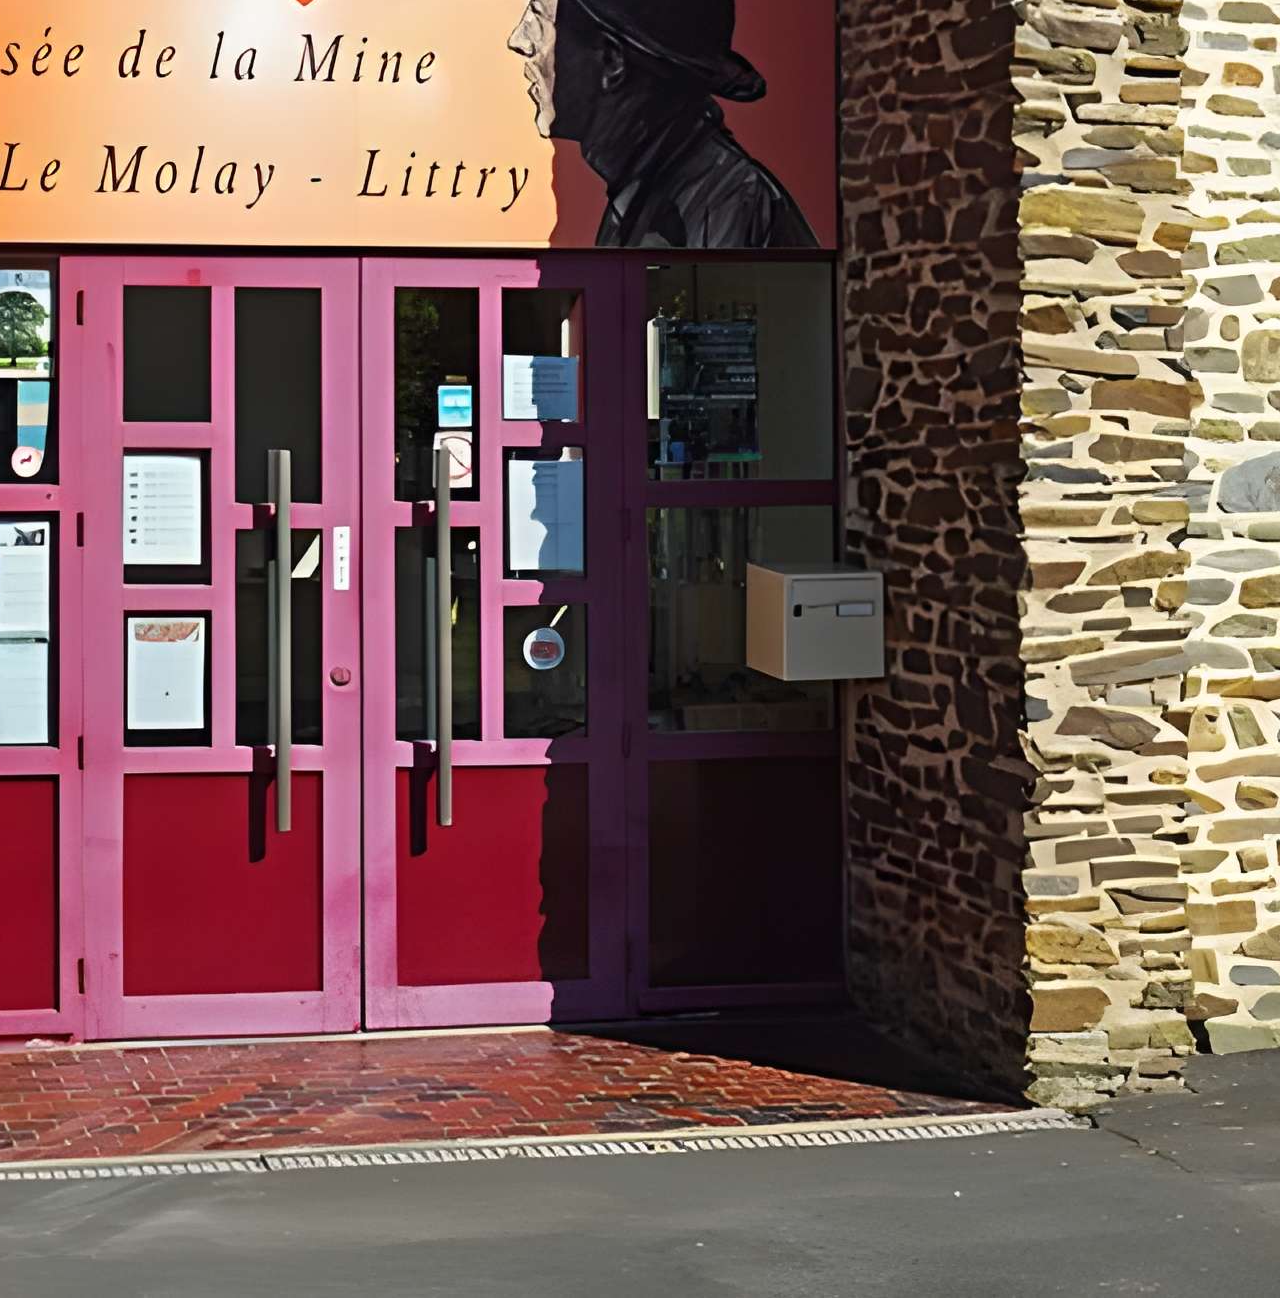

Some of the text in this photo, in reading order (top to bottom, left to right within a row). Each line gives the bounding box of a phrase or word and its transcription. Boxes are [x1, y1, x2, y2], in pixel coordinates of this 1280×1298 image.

[118, 28, 176, 79] de
[209, 30, 257, 81] la
[293, 33, 436, 84] Mine
[94, 144, 275, 210] Molay
[356, 149, 529, 213] Littry
